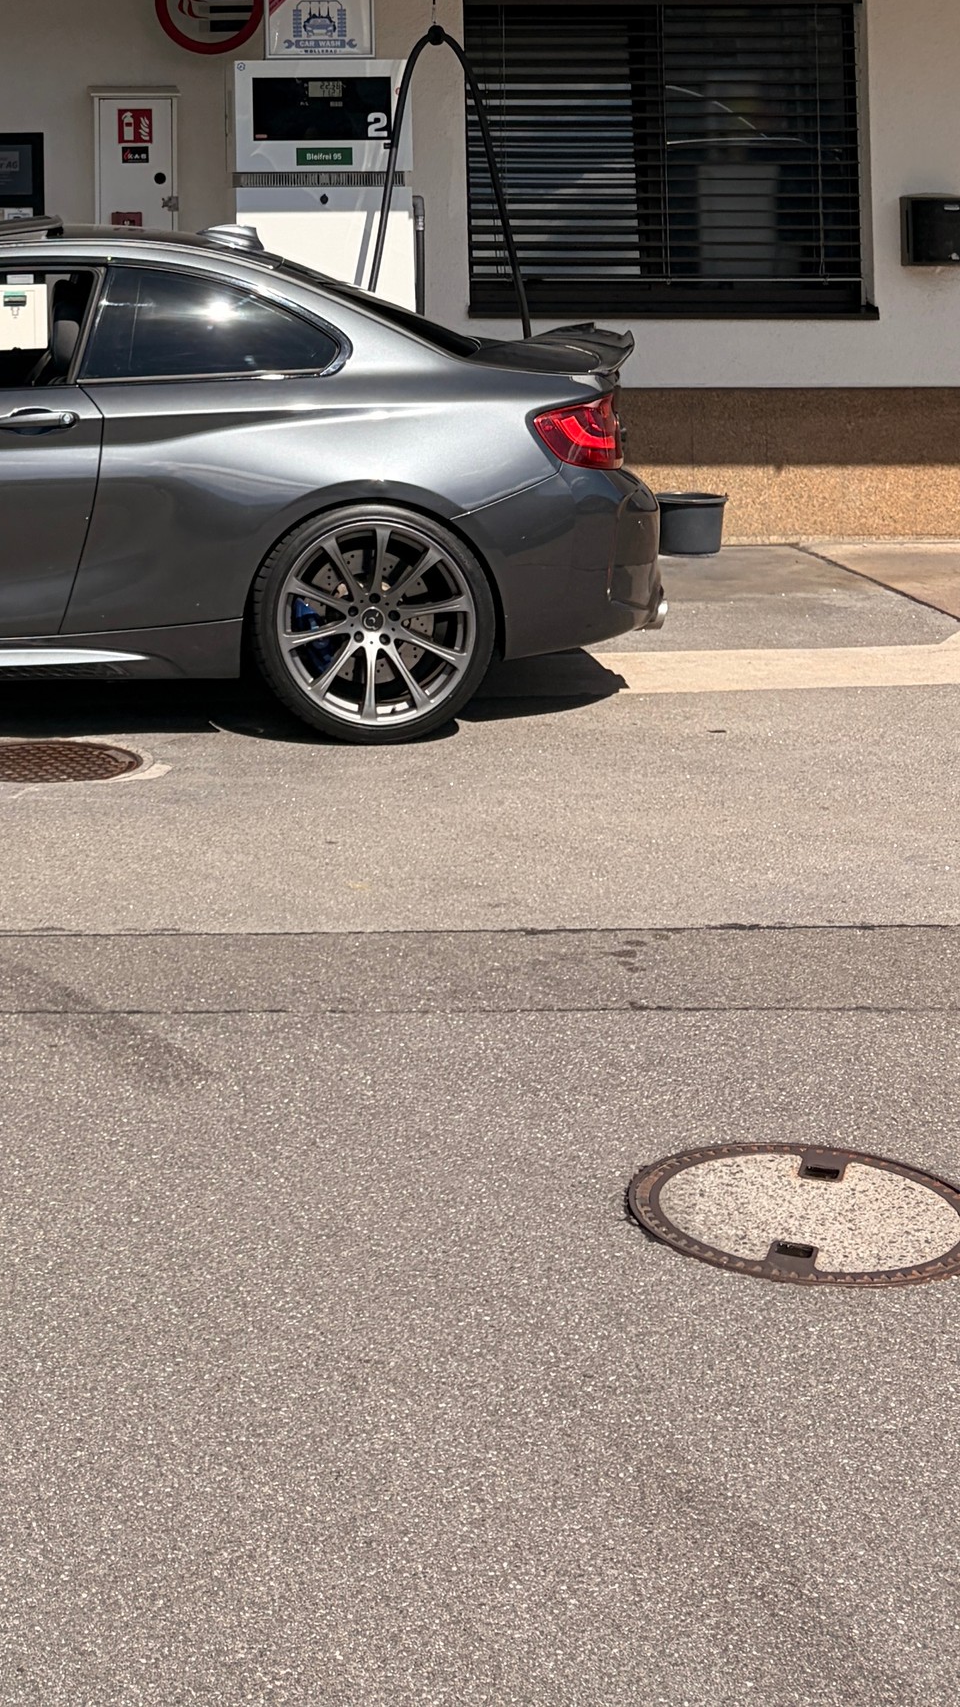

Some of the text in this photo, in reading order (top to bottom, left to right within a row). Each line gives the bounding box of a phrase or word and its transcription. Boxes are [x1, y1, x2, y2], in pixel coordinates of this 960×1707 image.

[367, 112, 388, 138] 2
[306, 152, 342, 161] Bleifrei 95
[5, 161, 18, 169] AG
